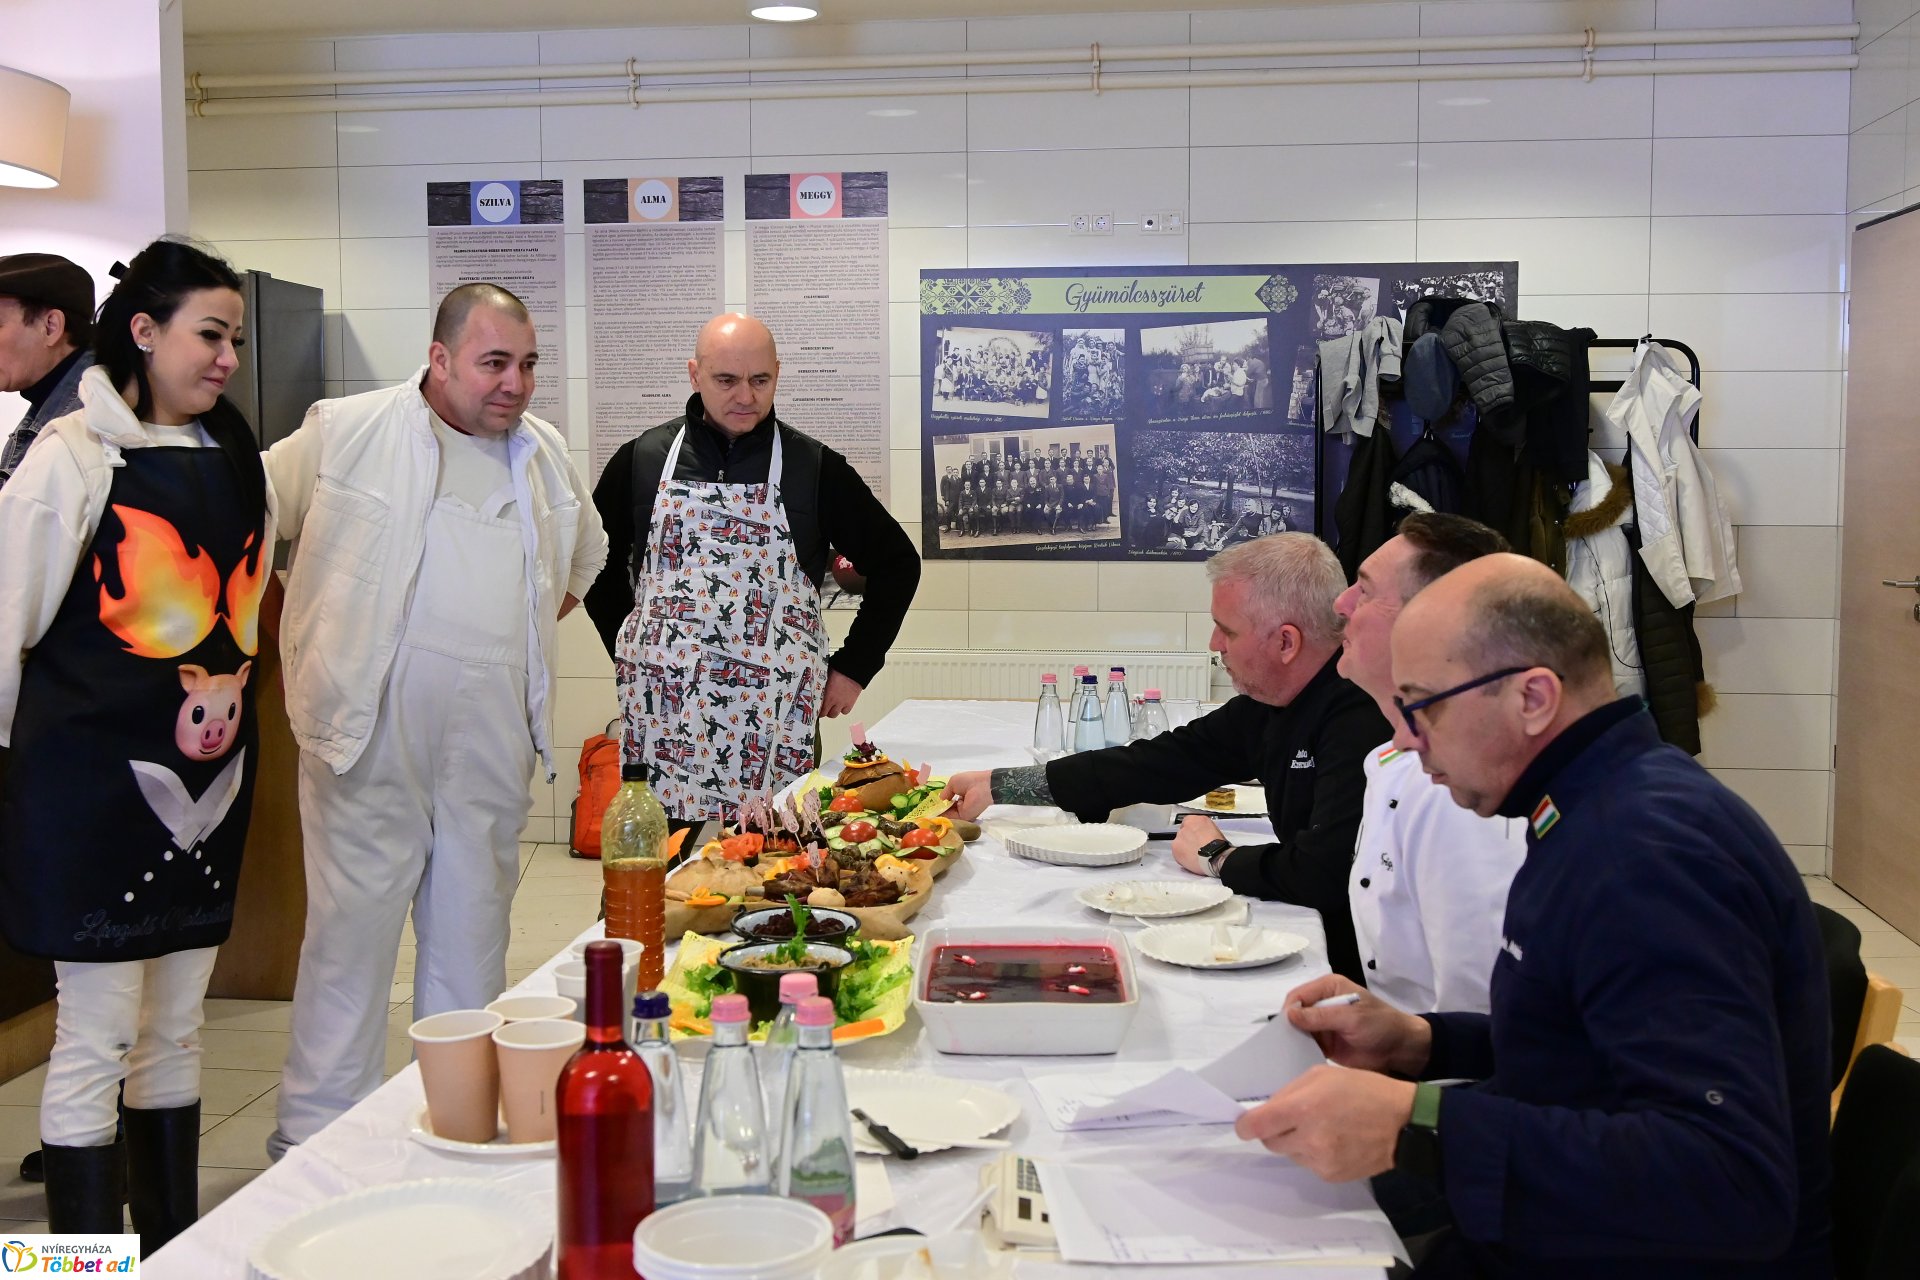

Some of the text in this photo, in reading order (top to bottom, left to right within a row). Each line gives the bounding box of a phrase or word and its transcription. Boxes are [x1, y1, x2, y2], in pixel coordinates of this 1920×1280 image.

[640, 195, 667, 204] ALMA
[799, 190, 833, 200] MEGGY
[479, 198, 512, 207] SZILVA
[1065, 279, 1206, 313] Gyümölcsszüret
